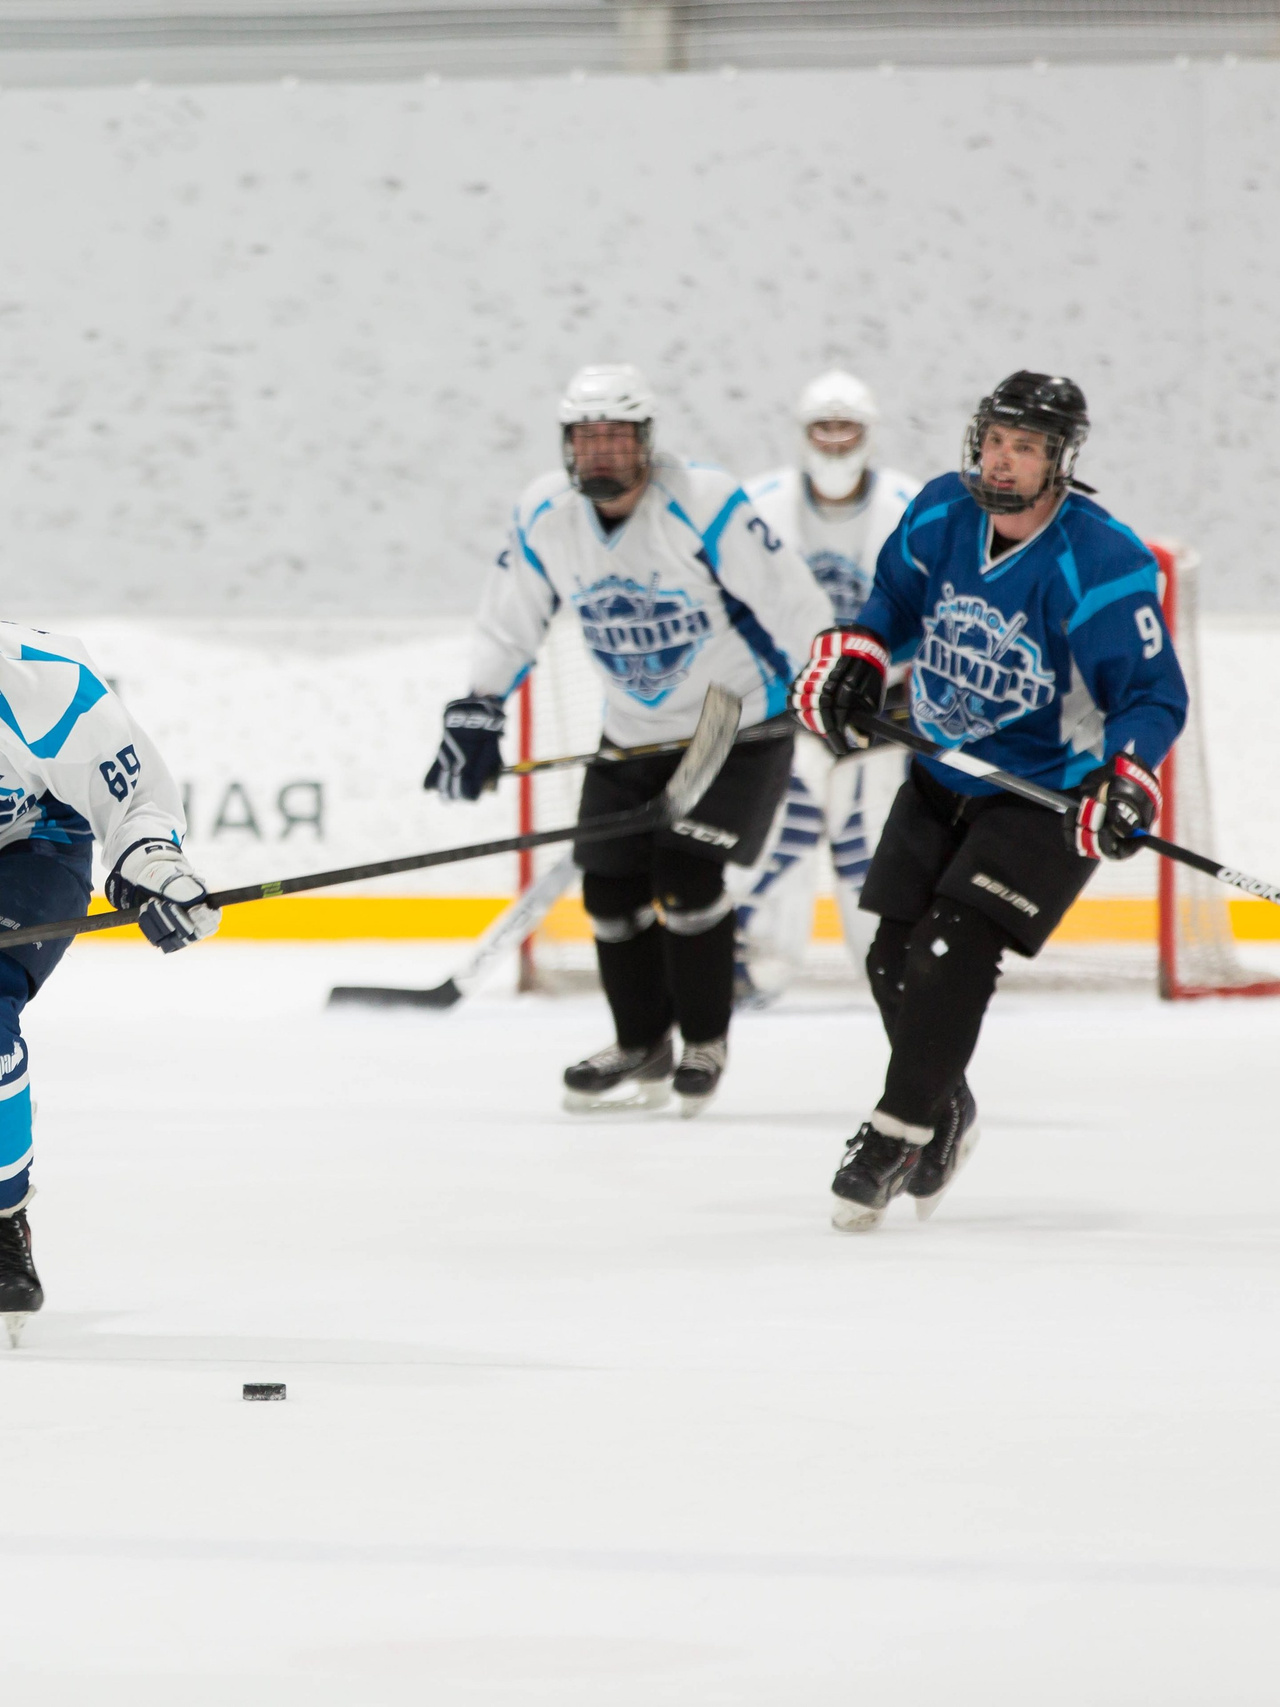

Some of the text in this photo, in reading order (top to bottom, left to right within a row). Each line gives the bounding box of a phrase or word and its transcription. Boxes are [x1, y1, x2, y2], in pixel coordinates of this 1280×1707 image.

[746, 517, 783, 552] 2
[1134, 606, 1163, 660] 9
[99, 743, 141, 803] 69
[671, 821, 740, 850] CCM
[971, 873, 1040, 918] BAUER
